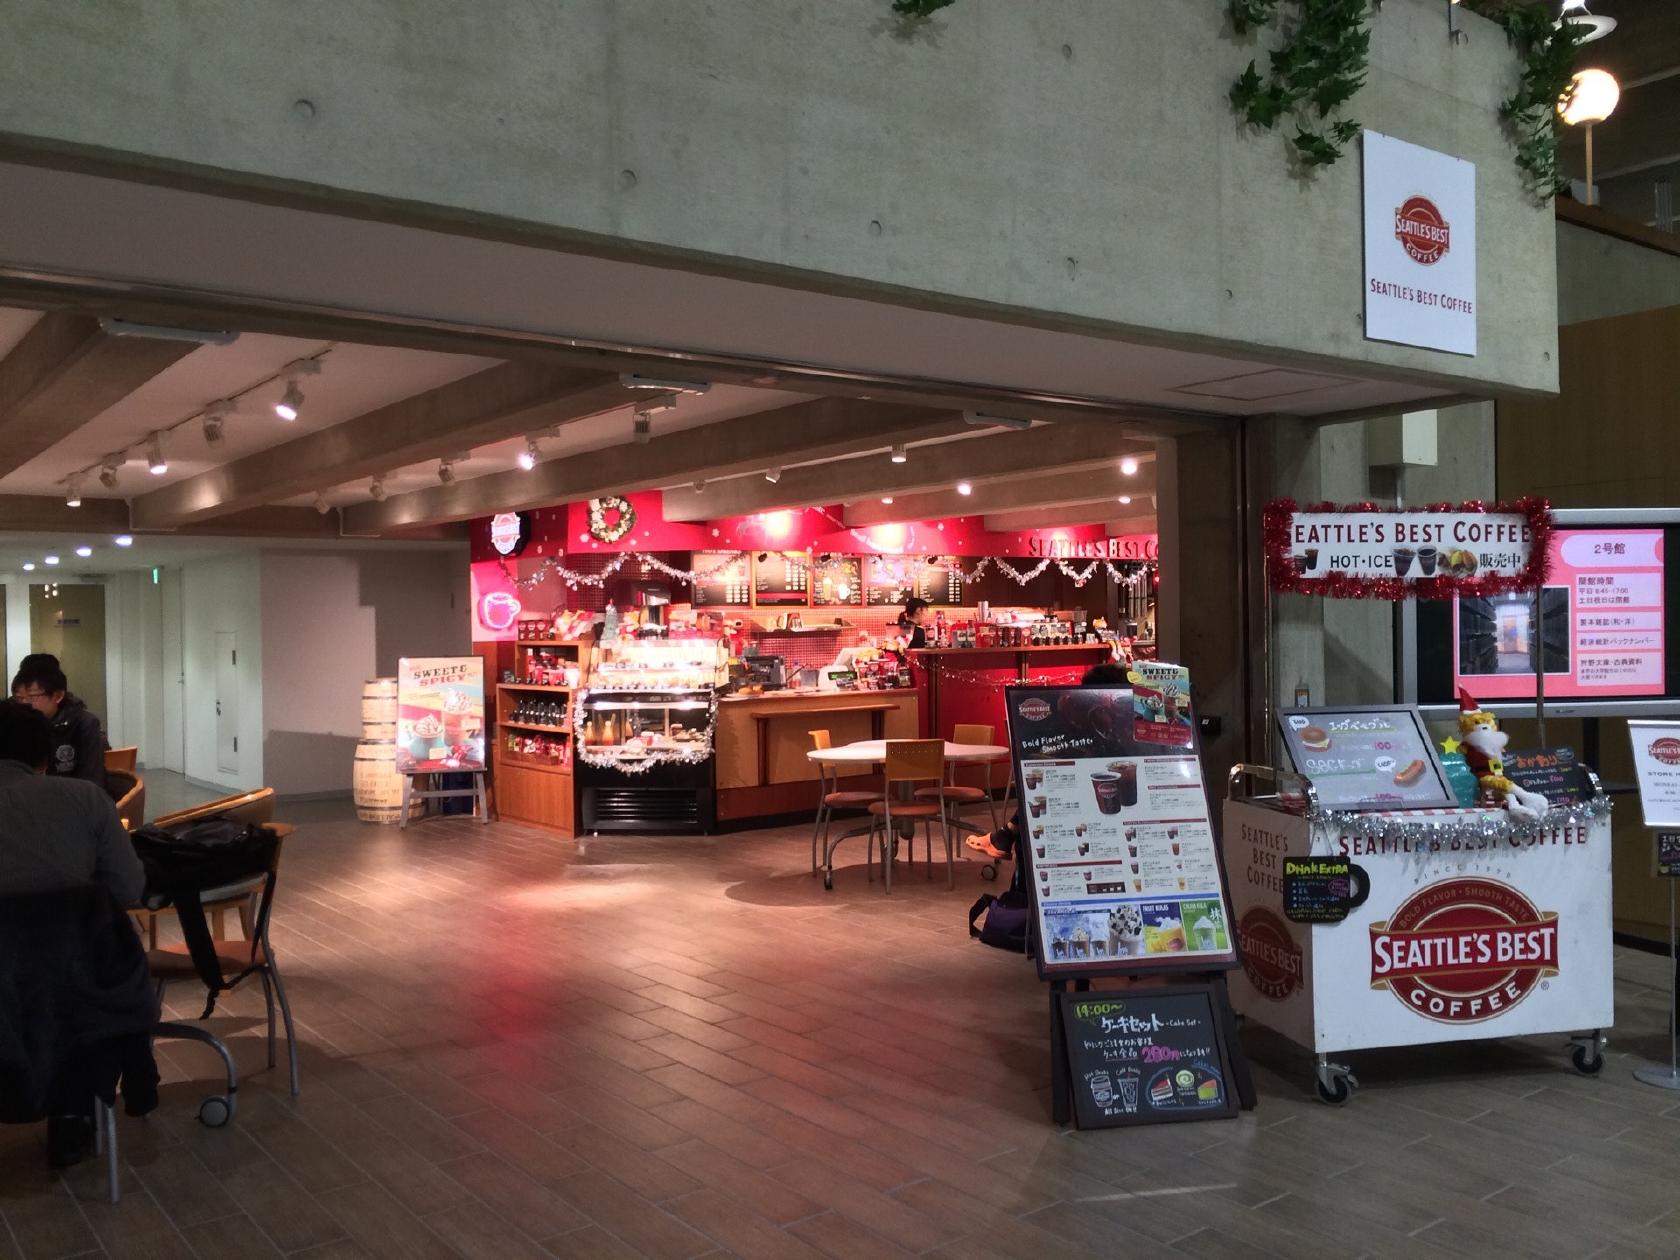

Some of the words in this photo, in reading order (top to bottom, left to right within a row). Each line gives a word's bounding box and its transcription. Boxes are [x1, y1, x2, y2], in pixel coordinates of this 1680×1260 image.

[1396, 214, 1431, 240] SEATTLE'S
[1431, 225, 1449, 245] BEST
[1406, 241, 1440, 264] COFFEE
[1416, 288, 1438, 307] BEST
[1440, 293, 1473, 315] COFFEE
[1293, 521, 1386, 544] EATTLE'S
[1395, 522, 1445, 544] BEST
[1453, 520, 1531, 544] COFFEE
[1480, 552, 1521, 569] 販売中
[1594, 542, 1626, 556] 2号館
[1022, 738, 1040, 749] Bold
[1042, 742, 1069, 753] Smooth
[1241, 823, 1289, 852] SEATTLE'S
[1253, 847, 1277, 869] BEST
[1286, 861, 1318, 875] Drink
[1247, 866, 1284, 894] COFFEE
[1399, 905, 1421, 929] BOLD
[1422, 889, 1457, 910] FLAVOR
[1465, 887, 1503, 902] SMOOTH
[1503, 893, 1530, 921] TASTE
[1278, 948, 1302, 977] BEST
[1374, 931, 1491, 975] SEATTLE'S
[1496, 927, 1555, 962] BEST
[1410, 981, 1521, 1017] COFFEE
[1101, 1013, 1165, 1034] ケーキセット
